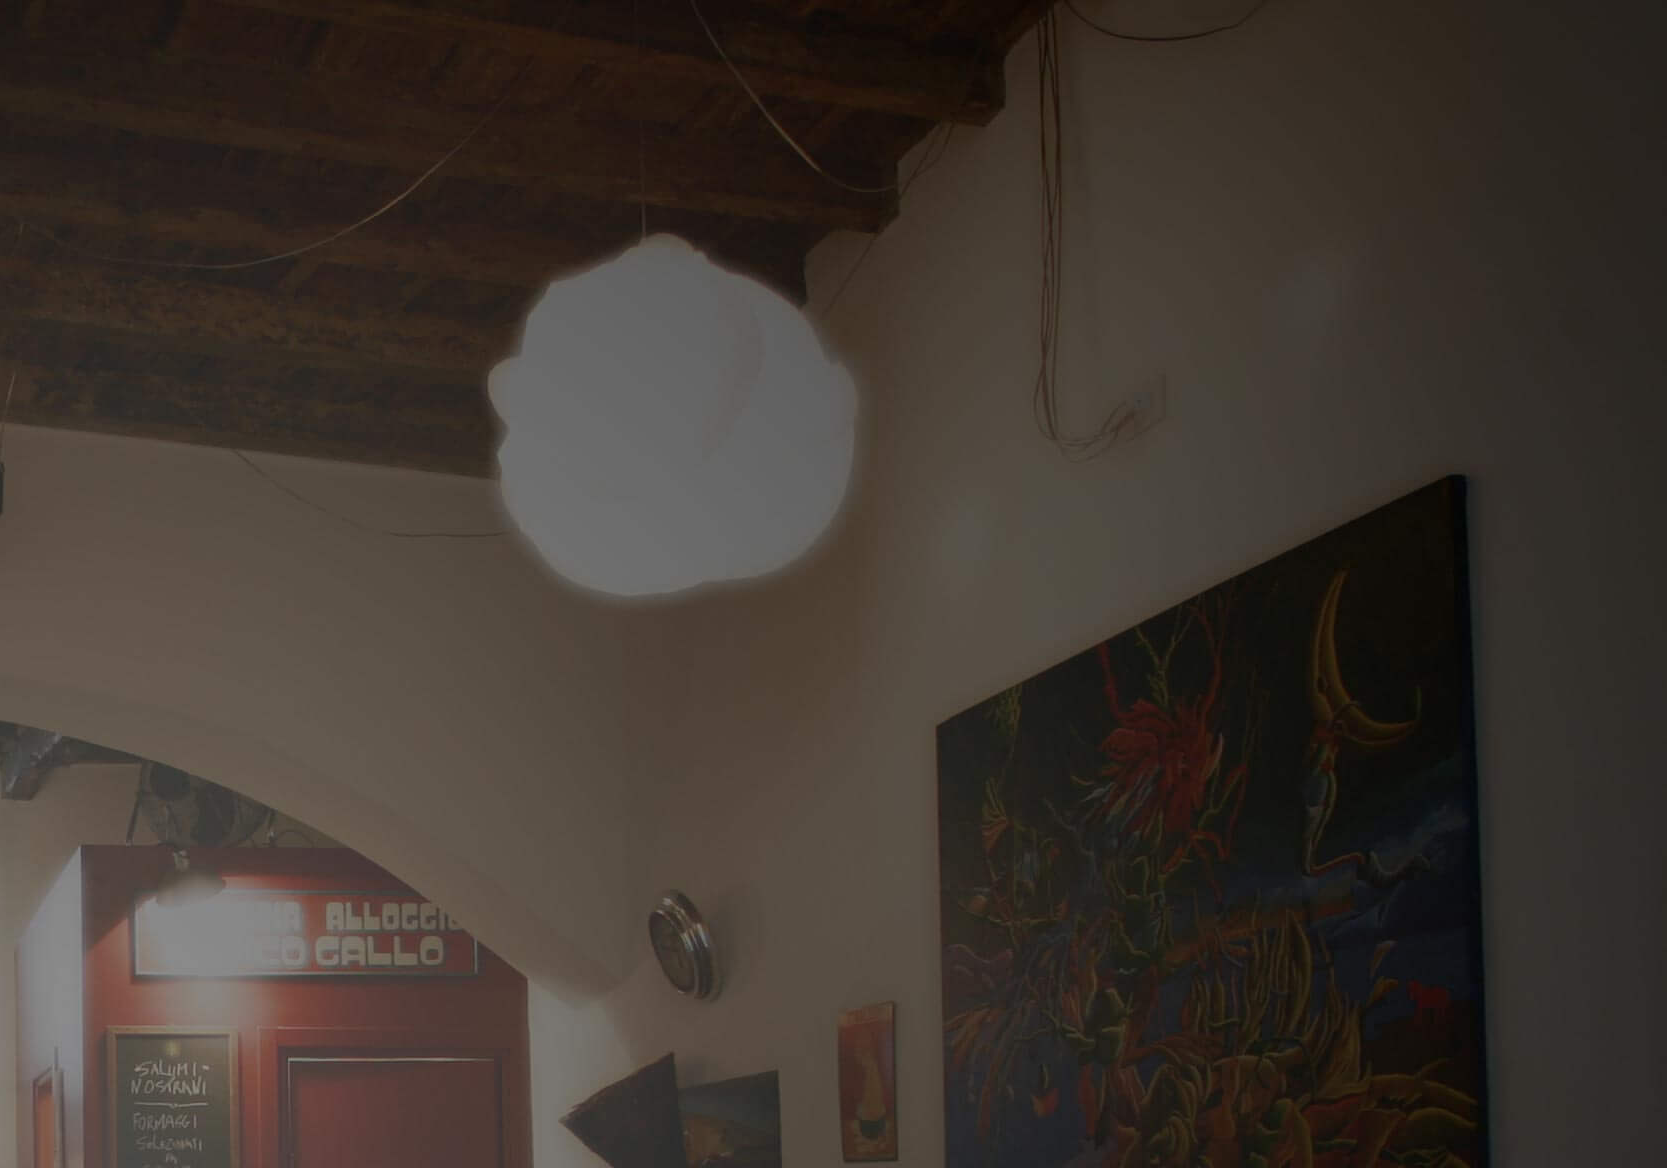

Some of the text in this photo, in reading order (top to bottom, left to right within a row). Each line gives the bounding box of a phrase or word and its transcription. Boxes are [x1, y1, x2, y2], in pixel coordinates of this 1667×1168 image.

[315, 935, 445, 966] GALLO
[139, 1058, 197, 1079] SALUMI
[130, 1075, 207, 1096] NOSTRANI
